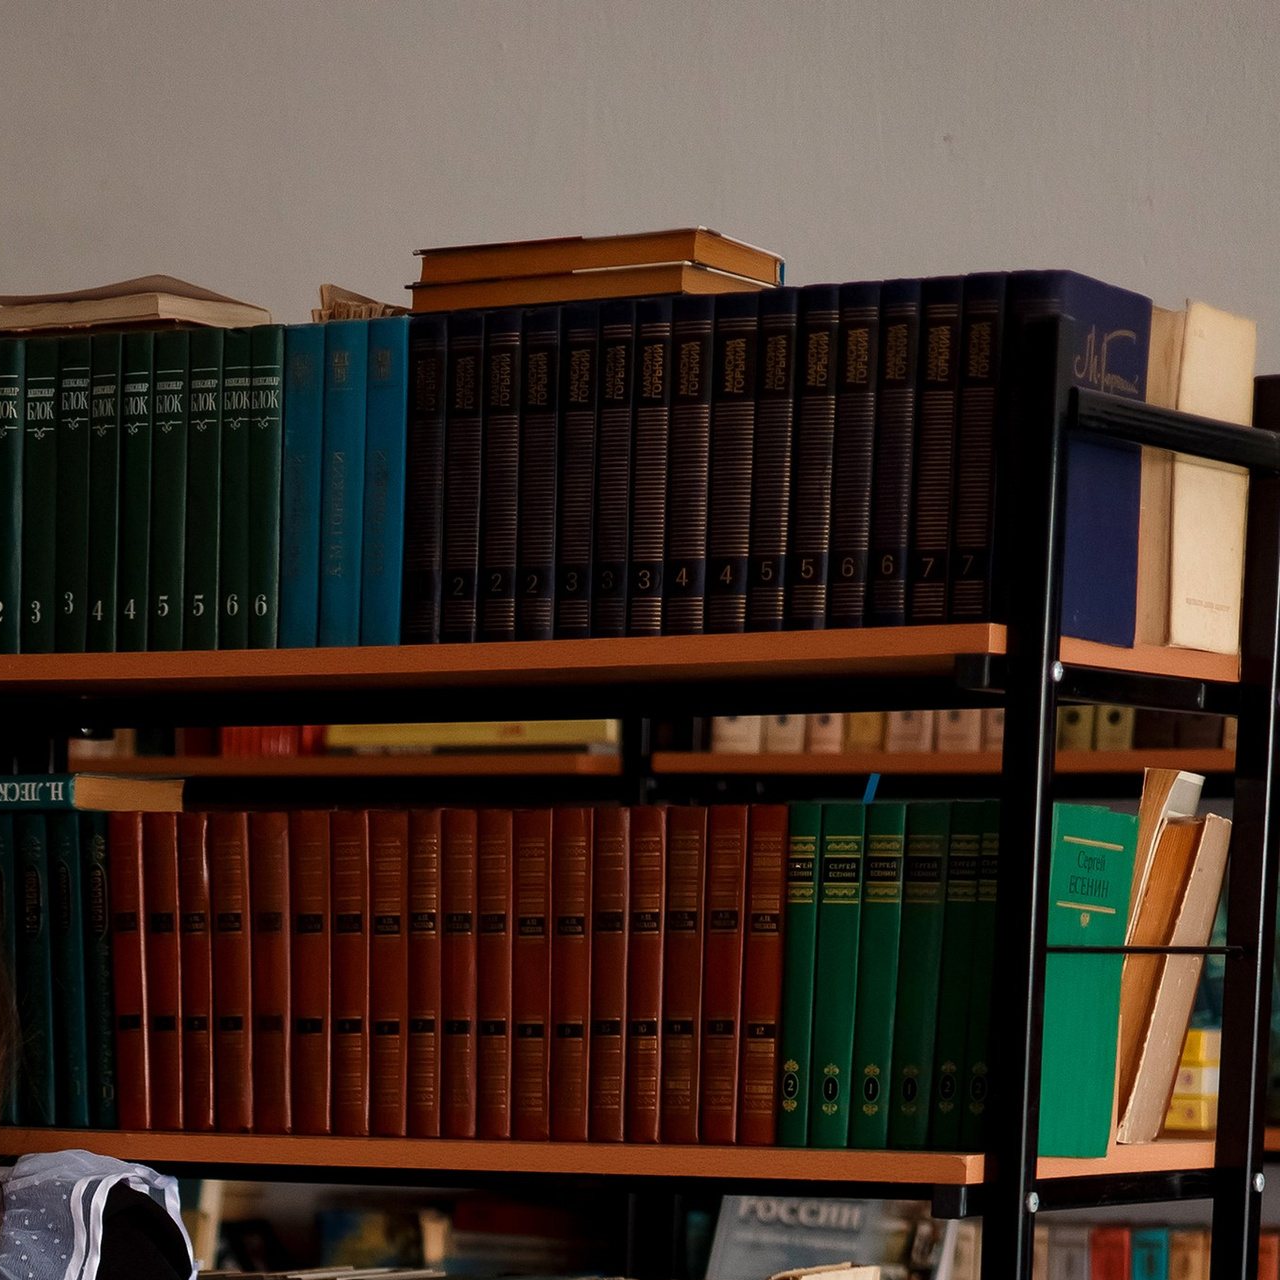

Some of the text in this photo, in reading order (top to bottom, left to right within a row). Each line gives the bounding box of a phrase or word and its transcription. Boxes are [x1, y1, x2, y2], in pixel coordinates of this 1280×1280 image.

[807, 333, 820, 386] МАКСИМ
[816, 331, 829, 387] ГОРЬКИЙ
[846, 330, 861, 383] МАКСИМ
[856, 327, 869, 384] ГОРЬКИЙ
[886, 325, 899, 379] МАКСИМ
[895, 324, 908, 379] ГОРЬКИЙ
[928, 326, 941, 381] МАКСИМ
[937, 325, 951, 382] ГОРЬКИЙ
[642, 346, 654, 397] МАКСИМ
[651, 343, 664, 398] ГОРЬКИЙ
[680, 344, 691, 395] МАКСИМ
[688, 341, 700, 396] ГОРЬКИЙ
[724, 339, 739, 392] МАКСИМ
[733, 338, 746, 393] ГОРЬКИЙ
[61, 391, 89, 410] БЛОК
[92, 397, 115, 418] БЛОК
[156, 393, 182, 414] БЛОК
[191, 391, 217, 412] БЛОК
[224, 390, 250, 410] БЛОК
[251, 389, 279, 409] БЛОК
[26, 401, 54, 420] БЛОК
[720, 565, 733, 585] 4
[761, 562, 773, 581] 5
[801, 559, 814, 579] 5
[841, 557, 854, 577] 6
[882, 555, 894, 574] 6
[922, 557, 934, 577] 7
[962, 555, 974, 574] 7
[491, 573, 502, 592] 2
[527, 574, 537, 593] 2
[567, 572, 577, 591] 3
[638, 570, 650, 589] 3
[676, 567, 688, 586] 4
[30, 601, 41, 623] 3
[64, 591, 74, 614] 3
[92, 600, 103, 620] 4
[124, 599, 136, 619] 4
[158, 595, 169, 616] 5
[193, 594, 205, 616] 5
[226, 594, 239, 615] 6
[255, 594, 267, 616] 6
[44, 782, 64, 801] Н.
[828, 862, 857, 870] СЕРГЕЙ
[870, 861, 897, 869] СЕРГЕЙ
[1077, 850, 1107, 875] Сергей
[870, 870, 896, 878] ЕСЕНИН
[1069, 874, 1110, 899] ЕСЕНИН
[787, 1079, 794, 1091] 2
